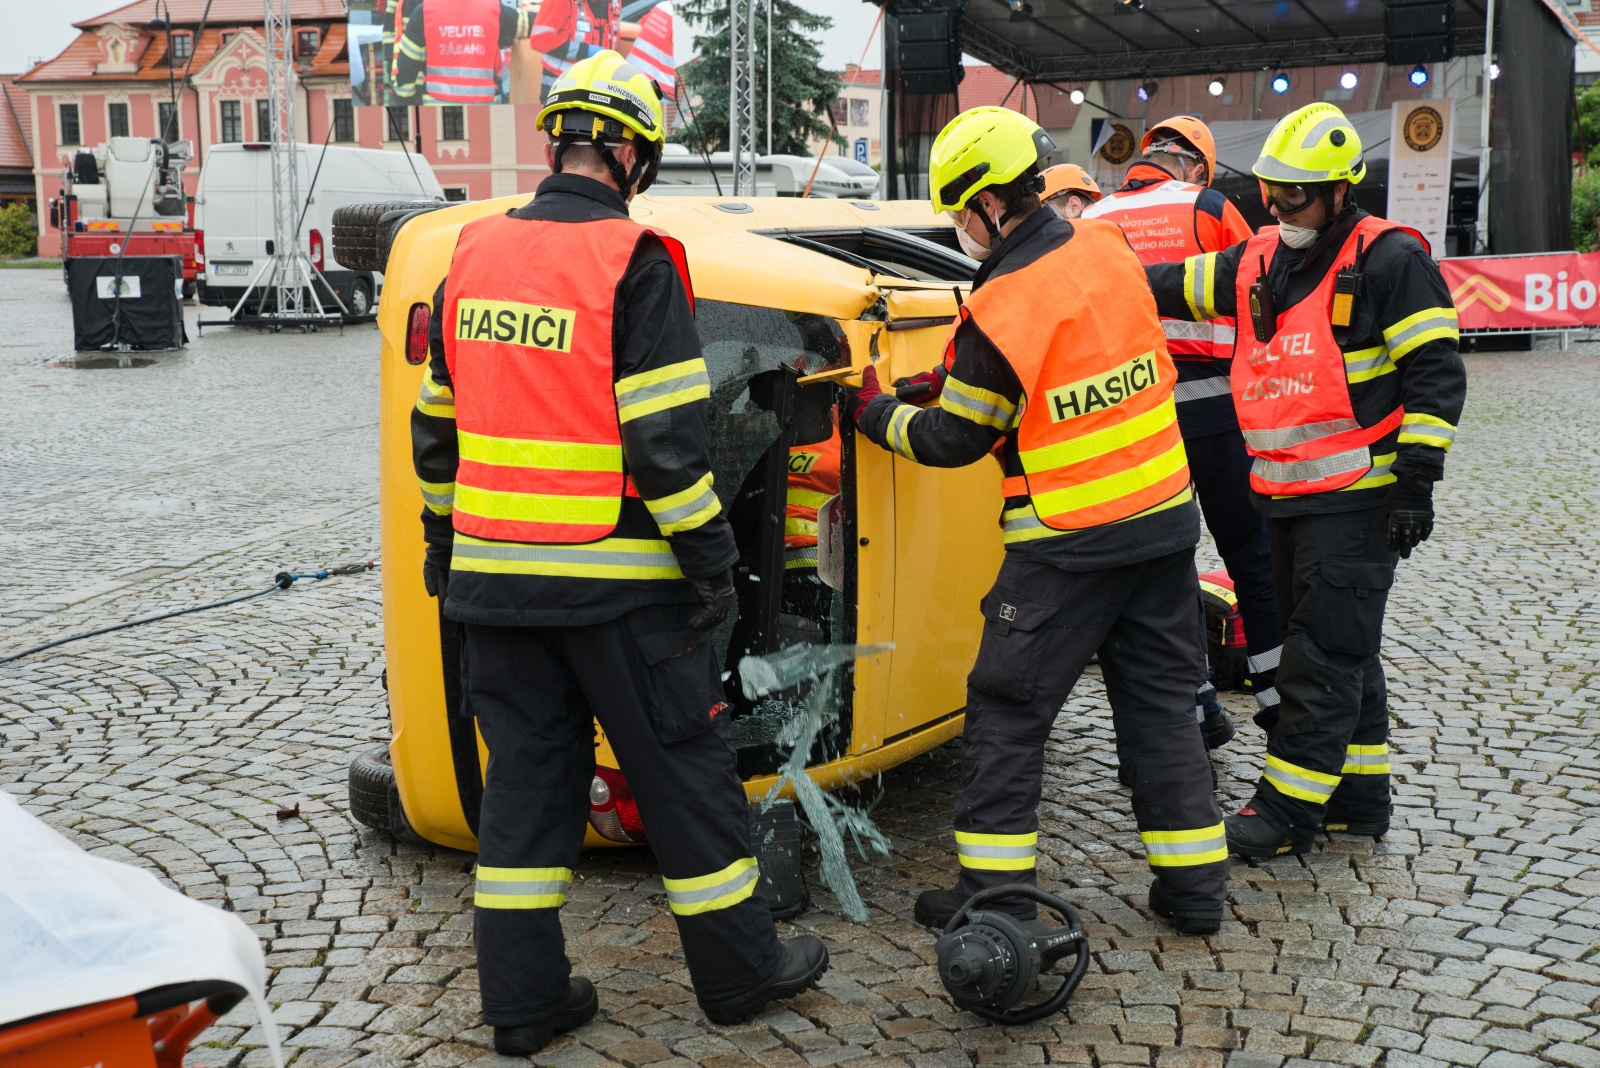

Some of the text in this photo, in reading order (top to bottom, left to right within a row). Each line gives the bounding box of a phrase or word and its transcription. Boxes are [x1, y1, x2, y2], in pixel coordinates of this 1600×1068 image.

[438, 25, 486, 38] VELITEL
[857, 143, 865, 160] P
[1146, 227, 1183, 237] SLUŽBA
[1158, 239, 1186, 249] KRAJE
[1525, 270, 1600, 312] Bio
[459, 308, 567, 350] HASIČI
[1053, 357, 1156, 420] HASIČI
[789, 451, 814, 472] ČI
